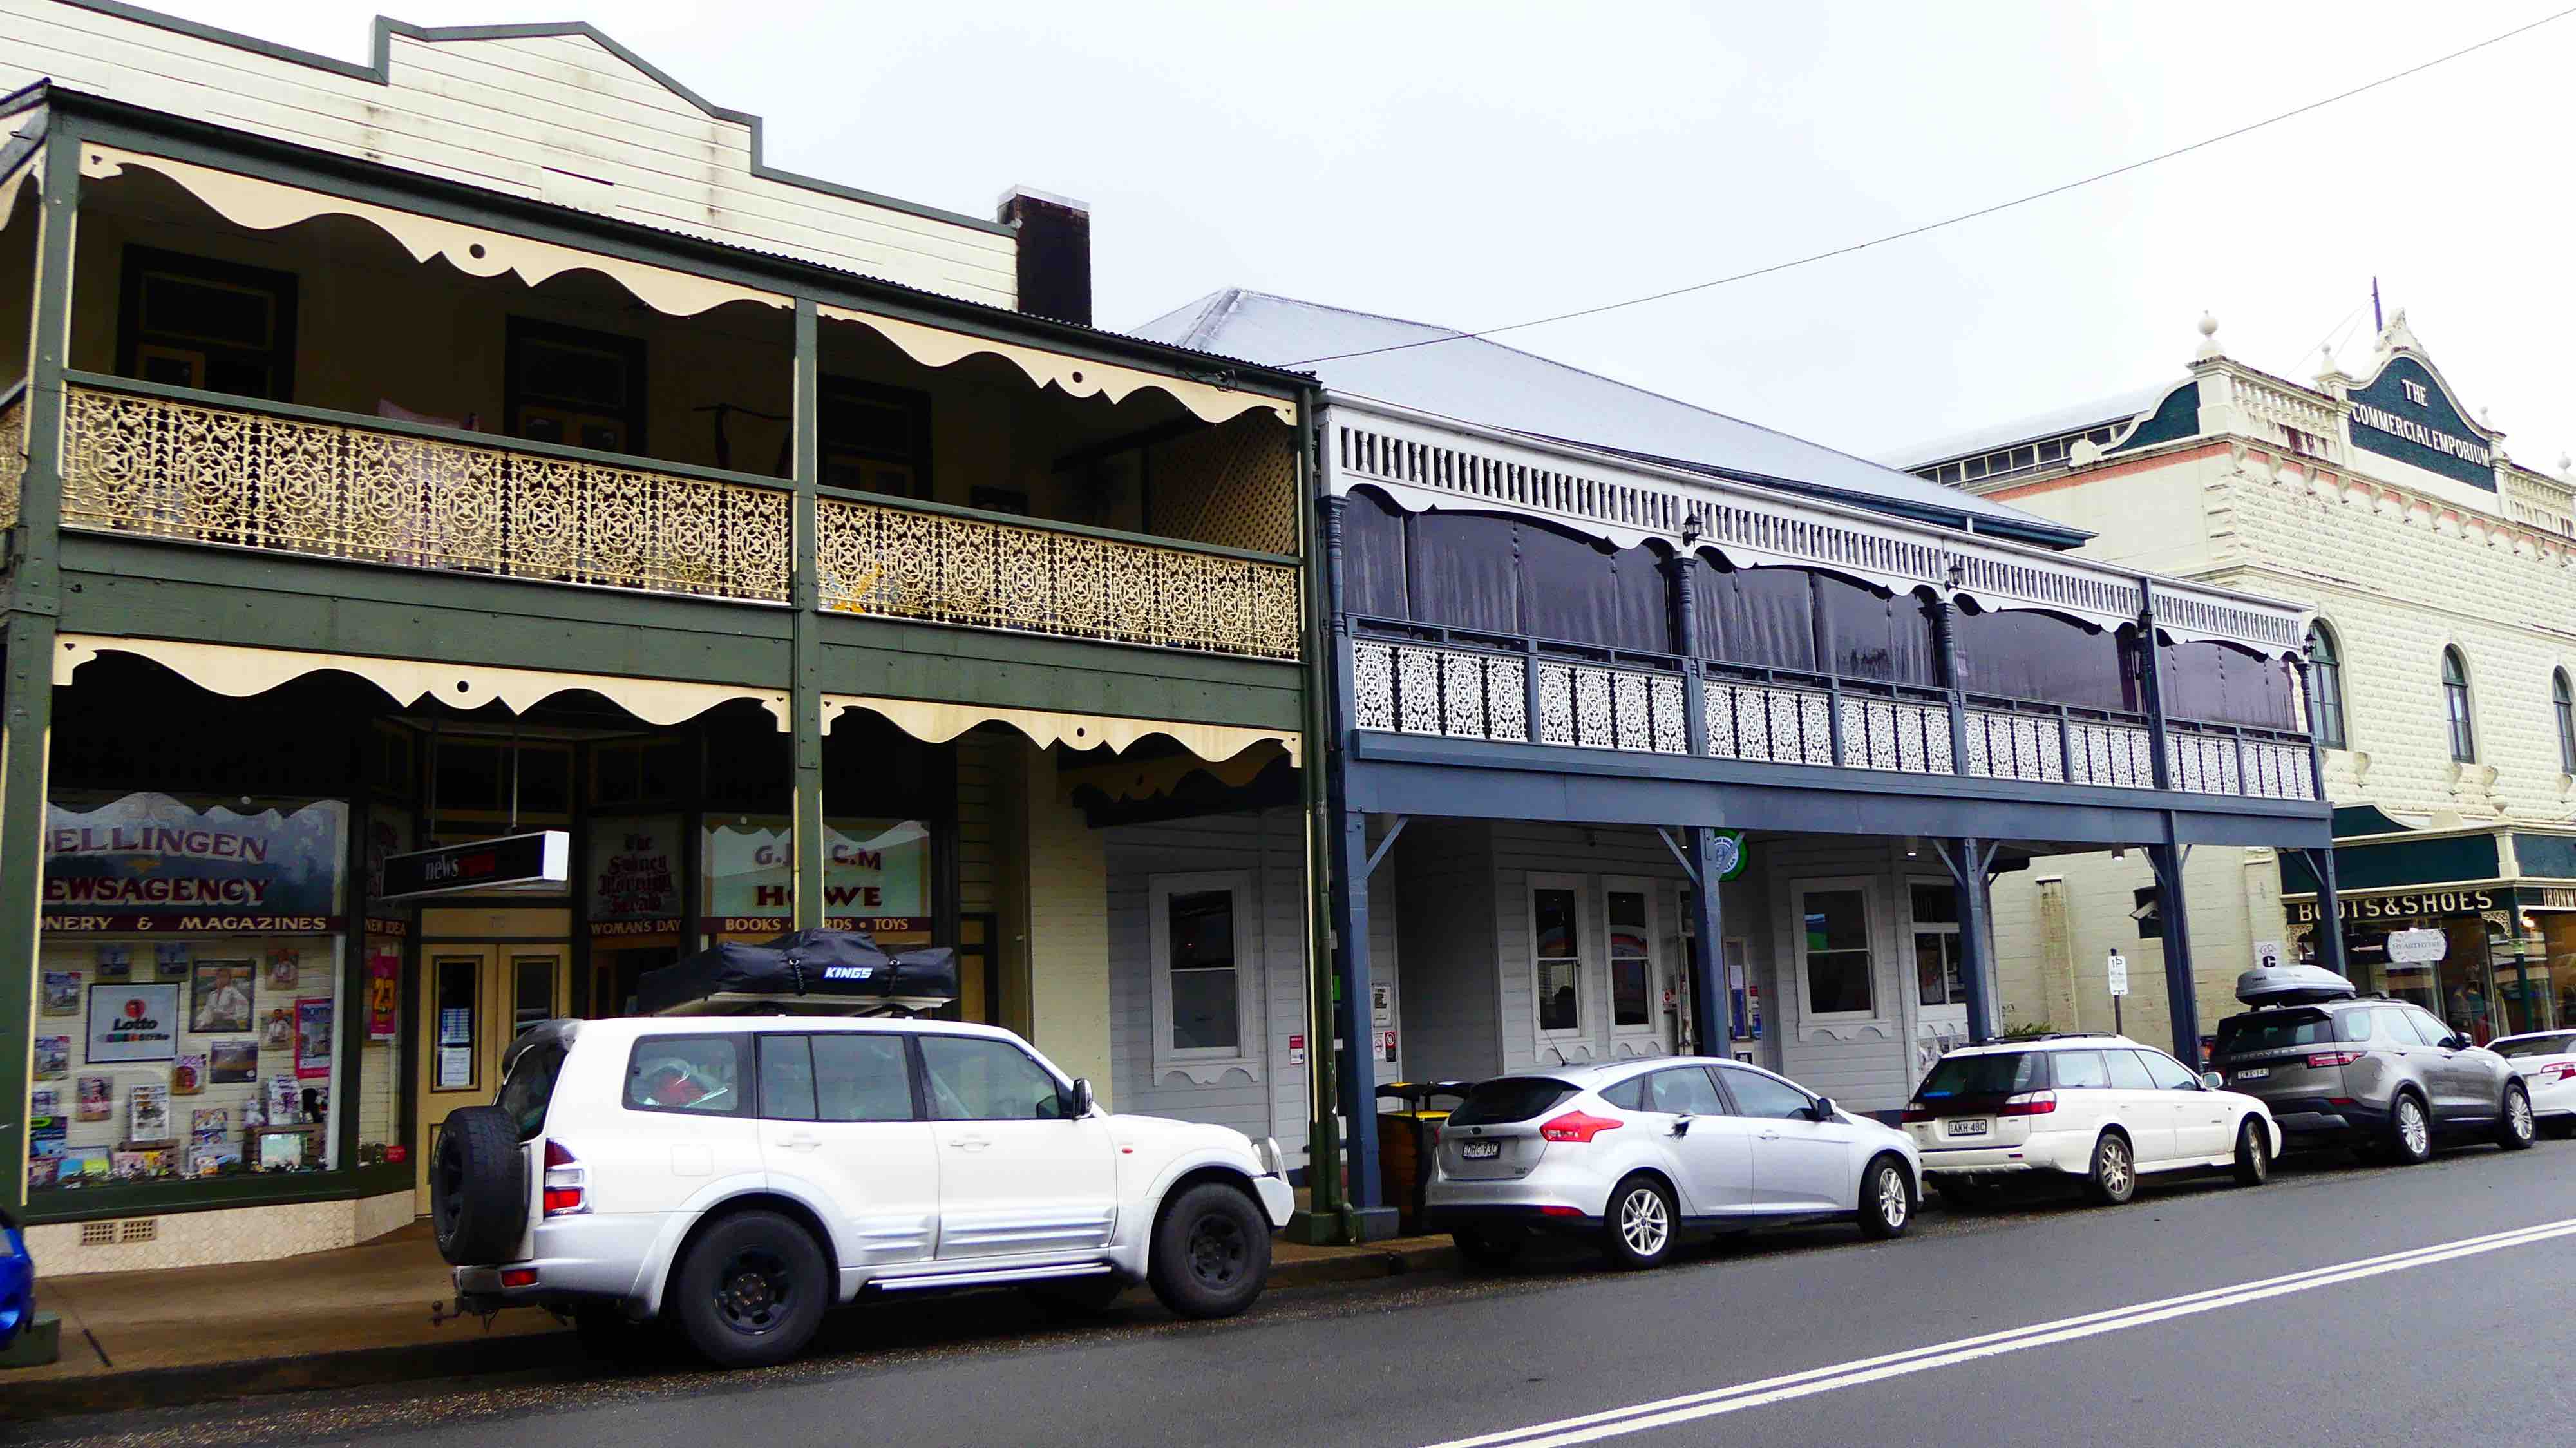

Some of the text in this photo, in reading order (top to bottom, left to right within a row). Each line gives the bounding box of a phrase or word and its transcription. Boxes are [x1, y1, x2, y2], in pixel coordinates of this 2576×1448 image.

[2401, 379, 2428, 407] THE
[2352, 403, 2491, 468] COMMERCIAL EMPORIUM
[43, 876, 271, 902] EWSAGENCY
[757, 886, 882, 907] HWE
[2543, 888, 2576, 907] IRONM
[137, 917, 153, 931] &
[179, 916, 327, 931] MAGAZINES
[365, 918, 383, 933] NEW
[656, 919, 681, 933] DAY
[725, 918, 781, 931] BOOKS
[875, 919, 908, 930] TOYS
[824, 967, 873, 980] KINGS
[113, 1017, 158, 1031] Lotto
